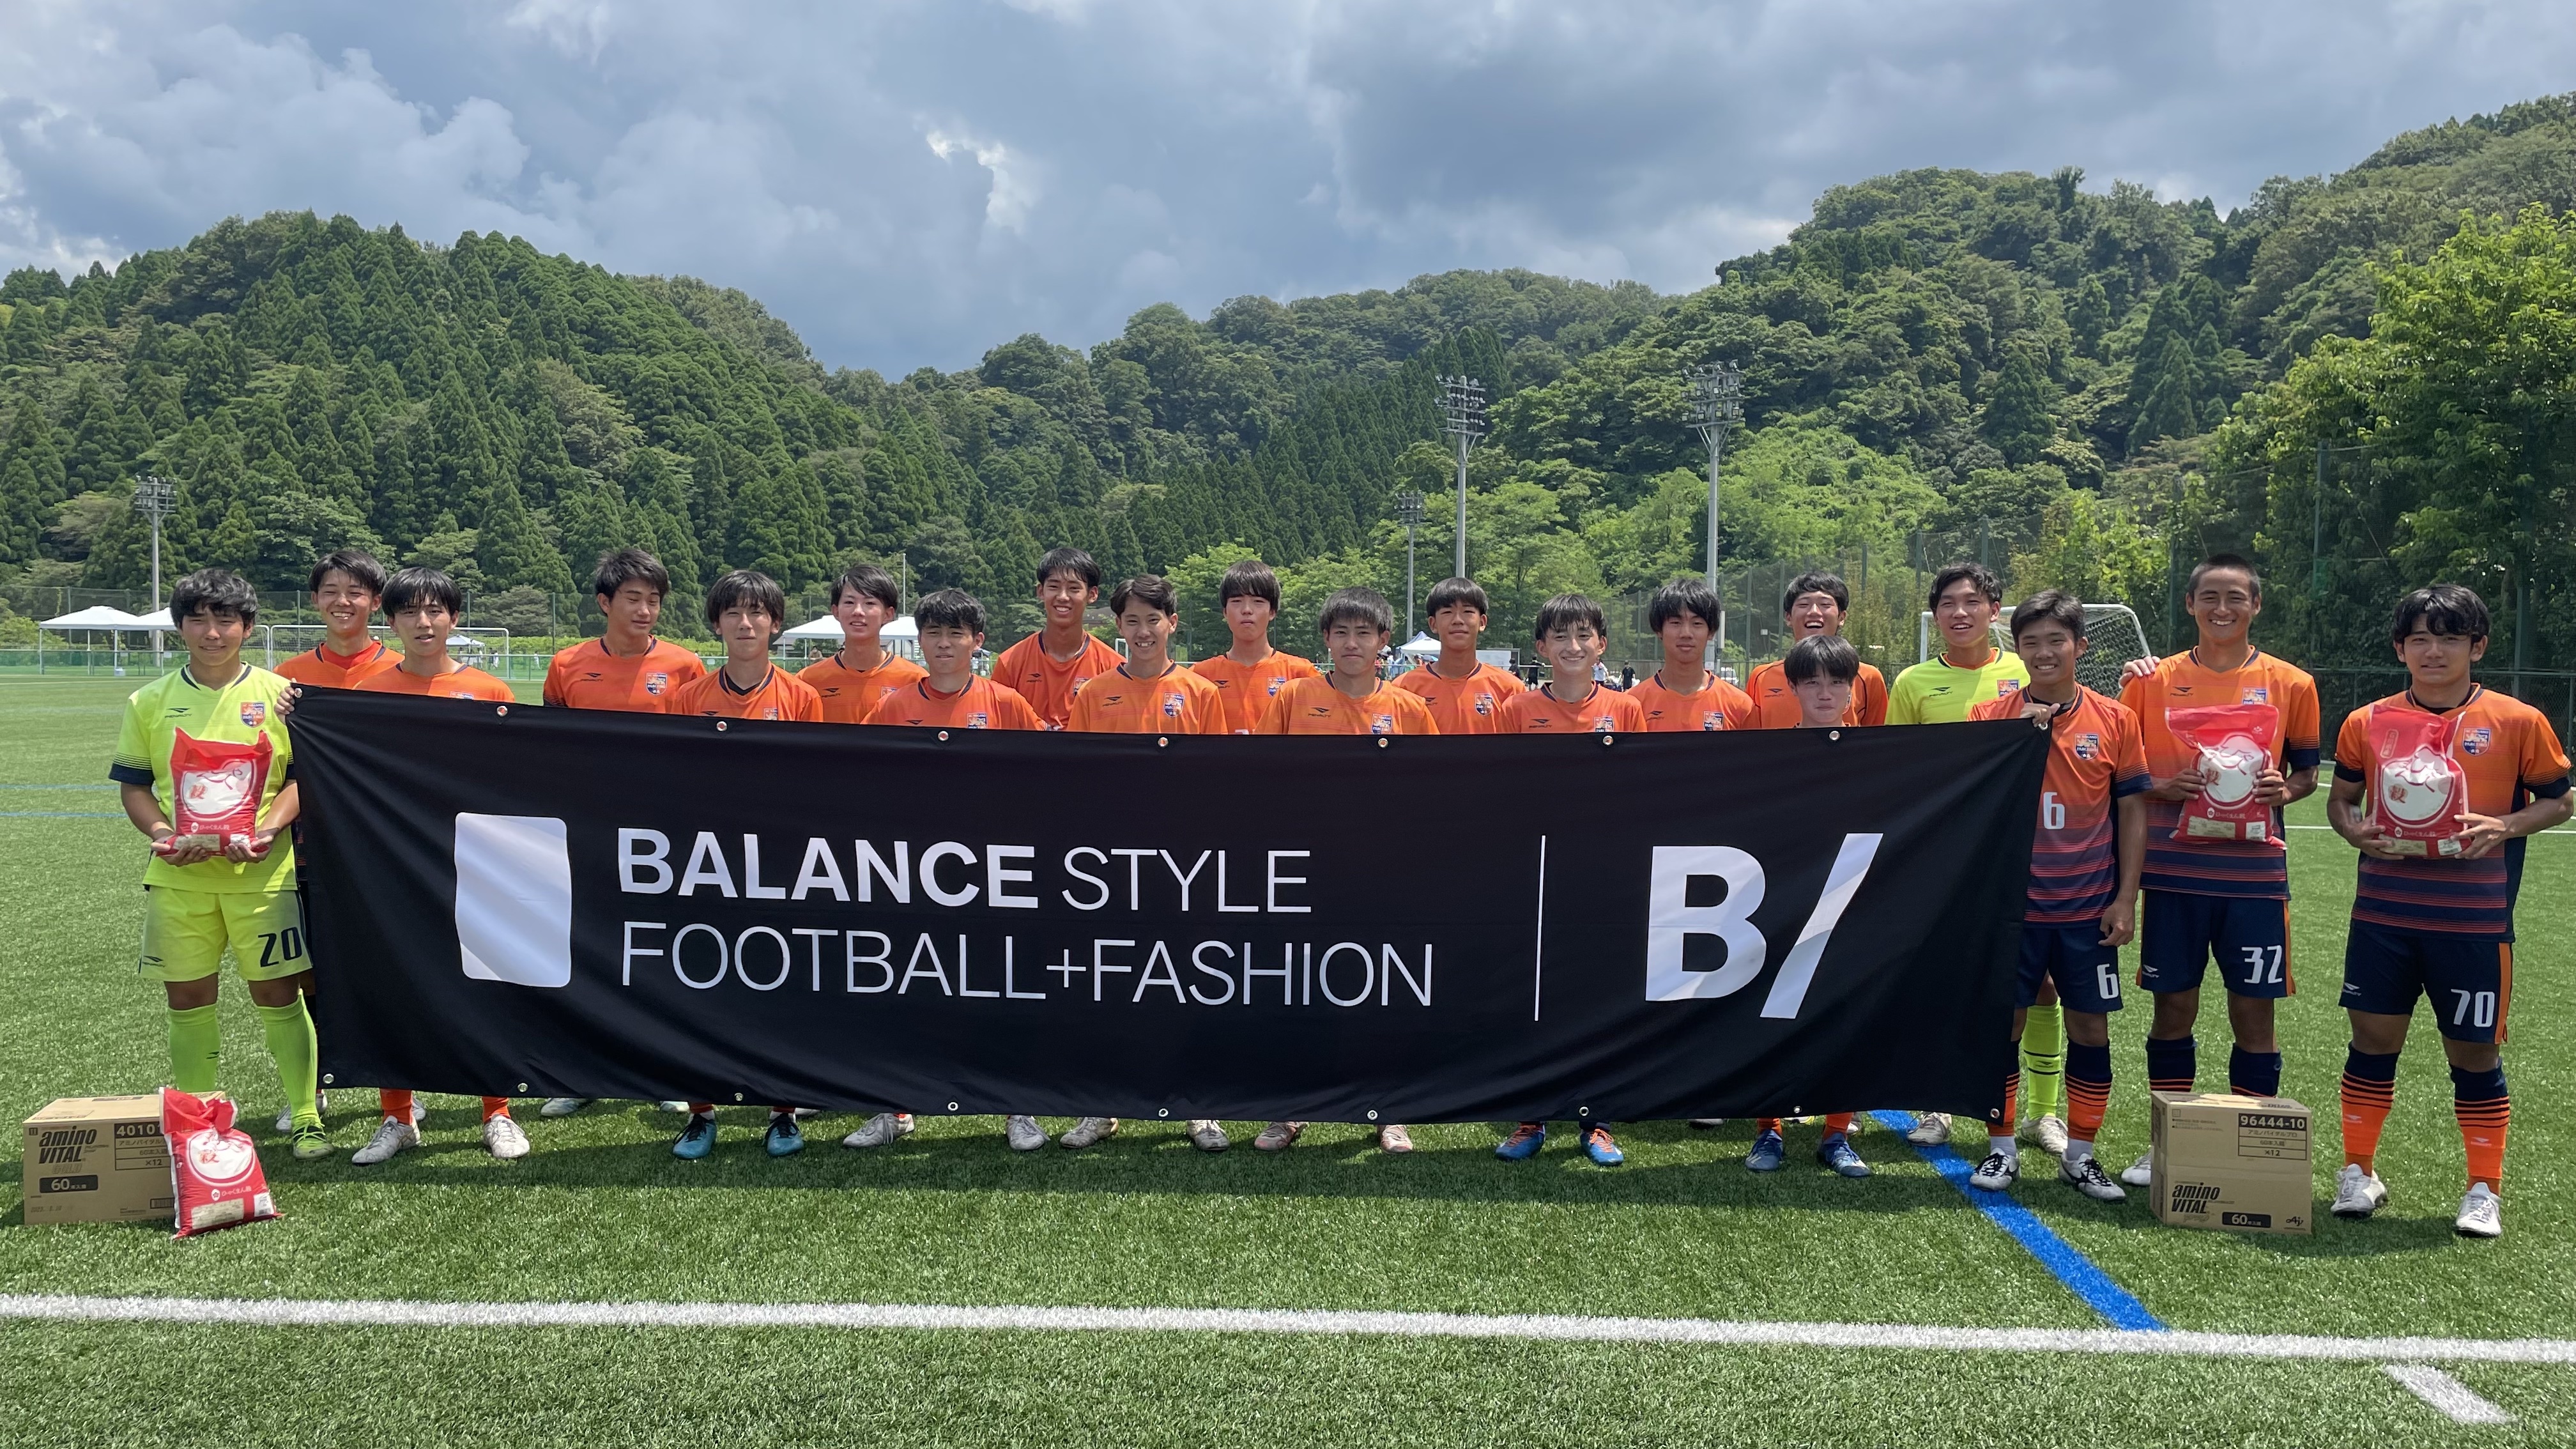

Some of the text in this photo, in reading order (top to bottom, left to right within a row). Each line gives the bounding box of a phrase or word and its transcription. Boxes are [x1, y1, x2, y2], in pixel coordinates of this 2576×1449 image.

[2043, 792, 2066, 830] 6
[618, 827, 1312, 912] BALANCE STYLE
[257, 926, 302, 968] 20
[622, 921, 1432, 1006] FOOTBALL+FASHION
[2241, 945, 2283, 984] 32
[2097, 963, 2119, 1000] 6
[2450, 988, 2496, 1028] 70
[39, 1126, 97, 1147] amino
[116, 1123, 160, 1137] 4010
[2241, 1115, 2305, 1129] 96444-10
[38, 1146, 82, 1164] VITAL
[2172, 1182, 2221, 1200] amino
[2172, 1198, 2208, 1214] VITAL
